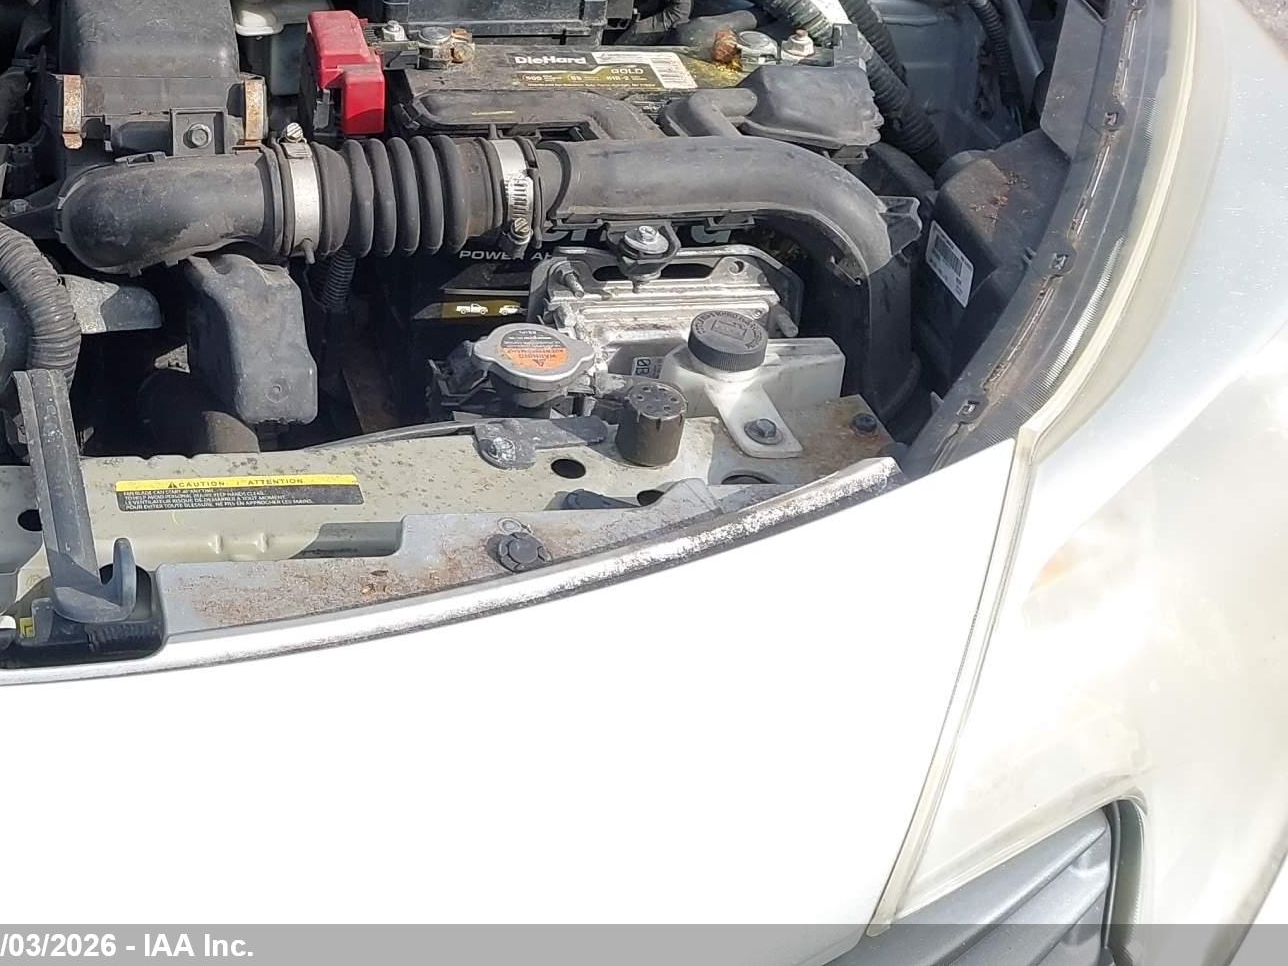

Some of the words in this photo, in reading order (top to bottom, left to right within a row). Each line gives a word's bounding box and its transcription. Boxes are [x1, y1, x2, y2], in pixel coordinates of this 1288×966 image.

[514, 55, 587, 65] DieHard
[610, 67, 644, 75] GOLD
[247, 478, 304, 486] ATTENTION
